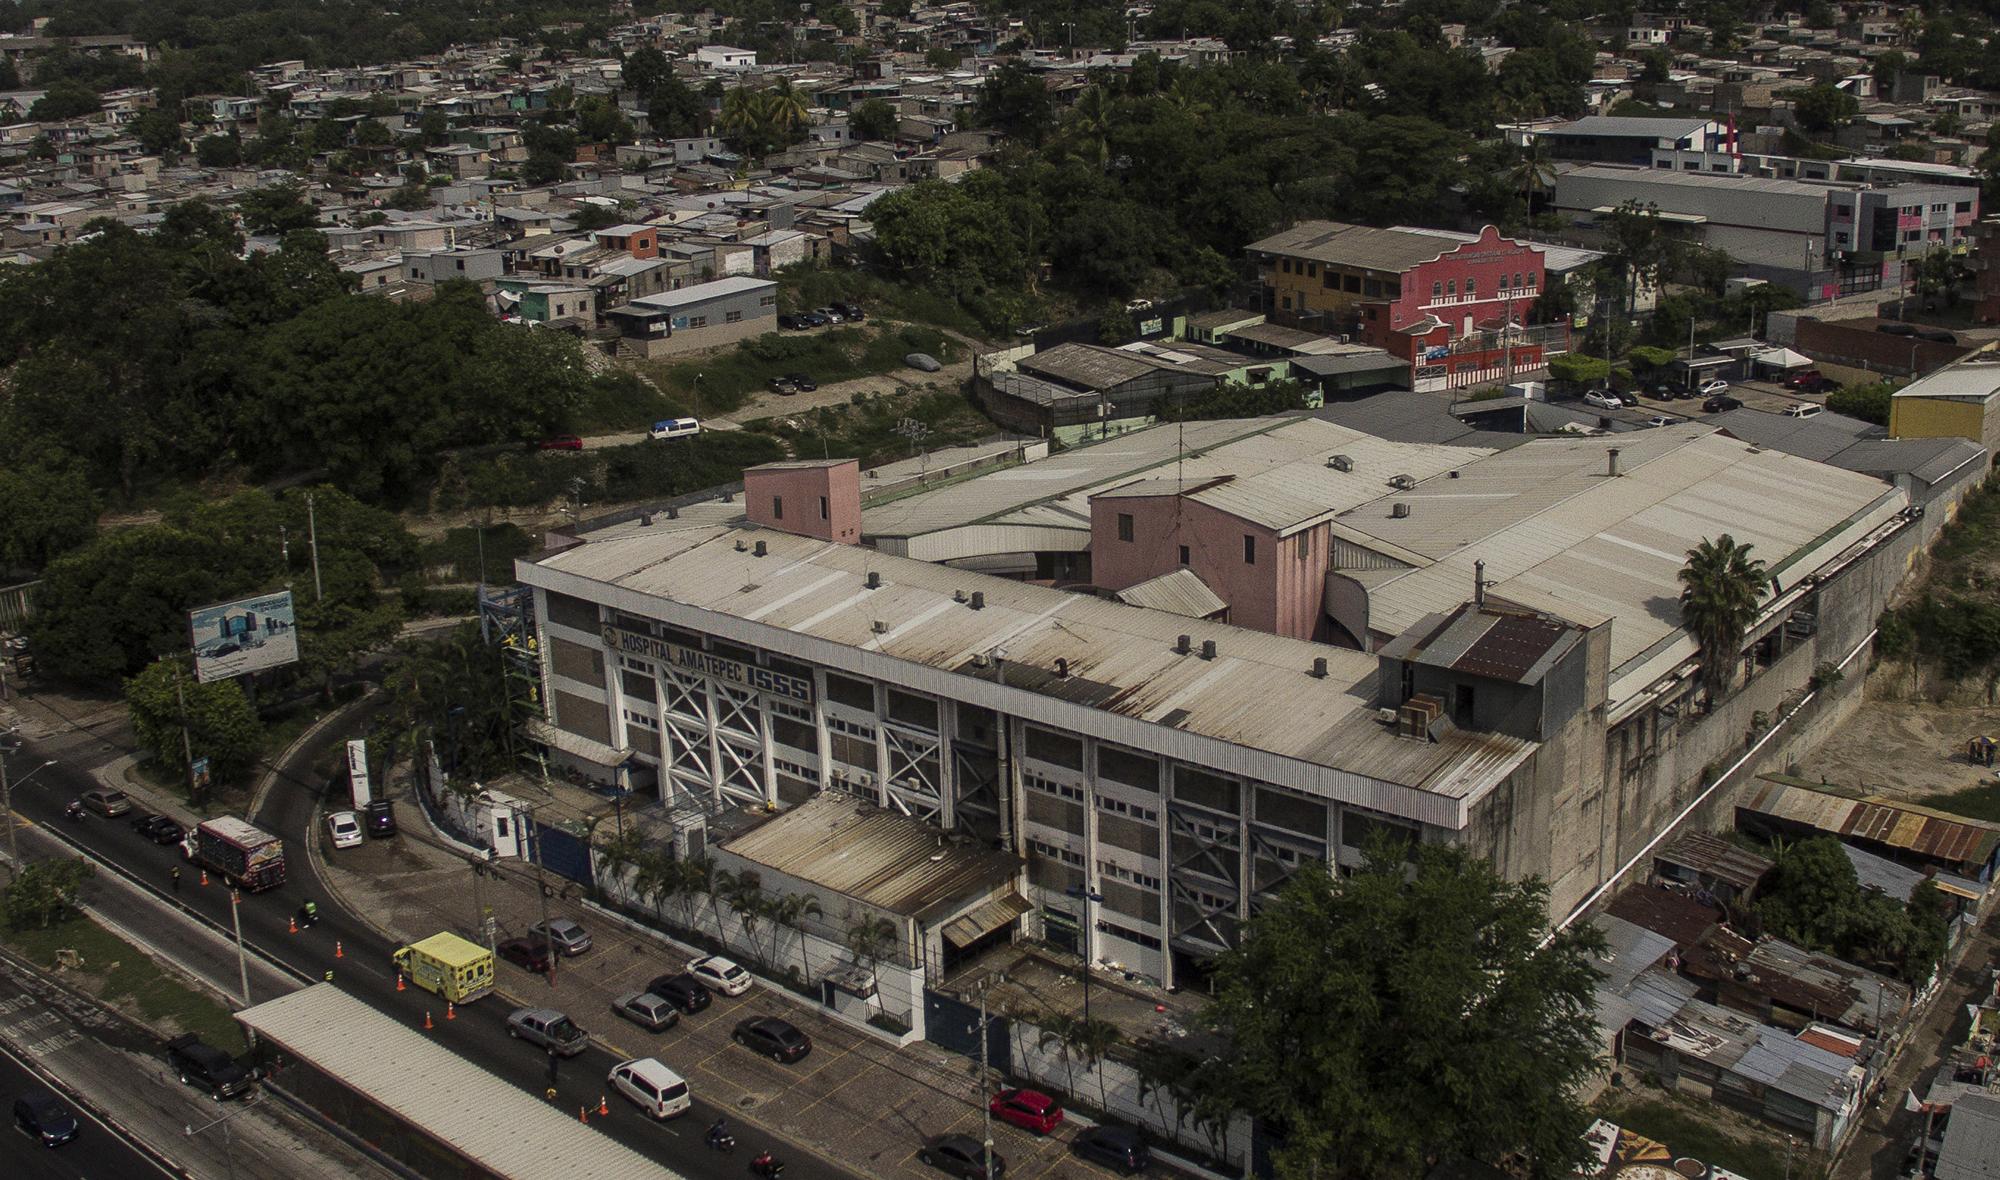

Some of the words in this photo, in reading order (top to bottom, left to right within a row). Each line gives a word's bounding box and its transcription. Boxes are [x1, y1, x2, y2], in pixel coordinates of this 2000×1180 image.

[621, 631, 674, 662] HOSPITAL
[678, 650, 742, 682] AMATEPEC
[747, 666, 808, 699] ISSS
